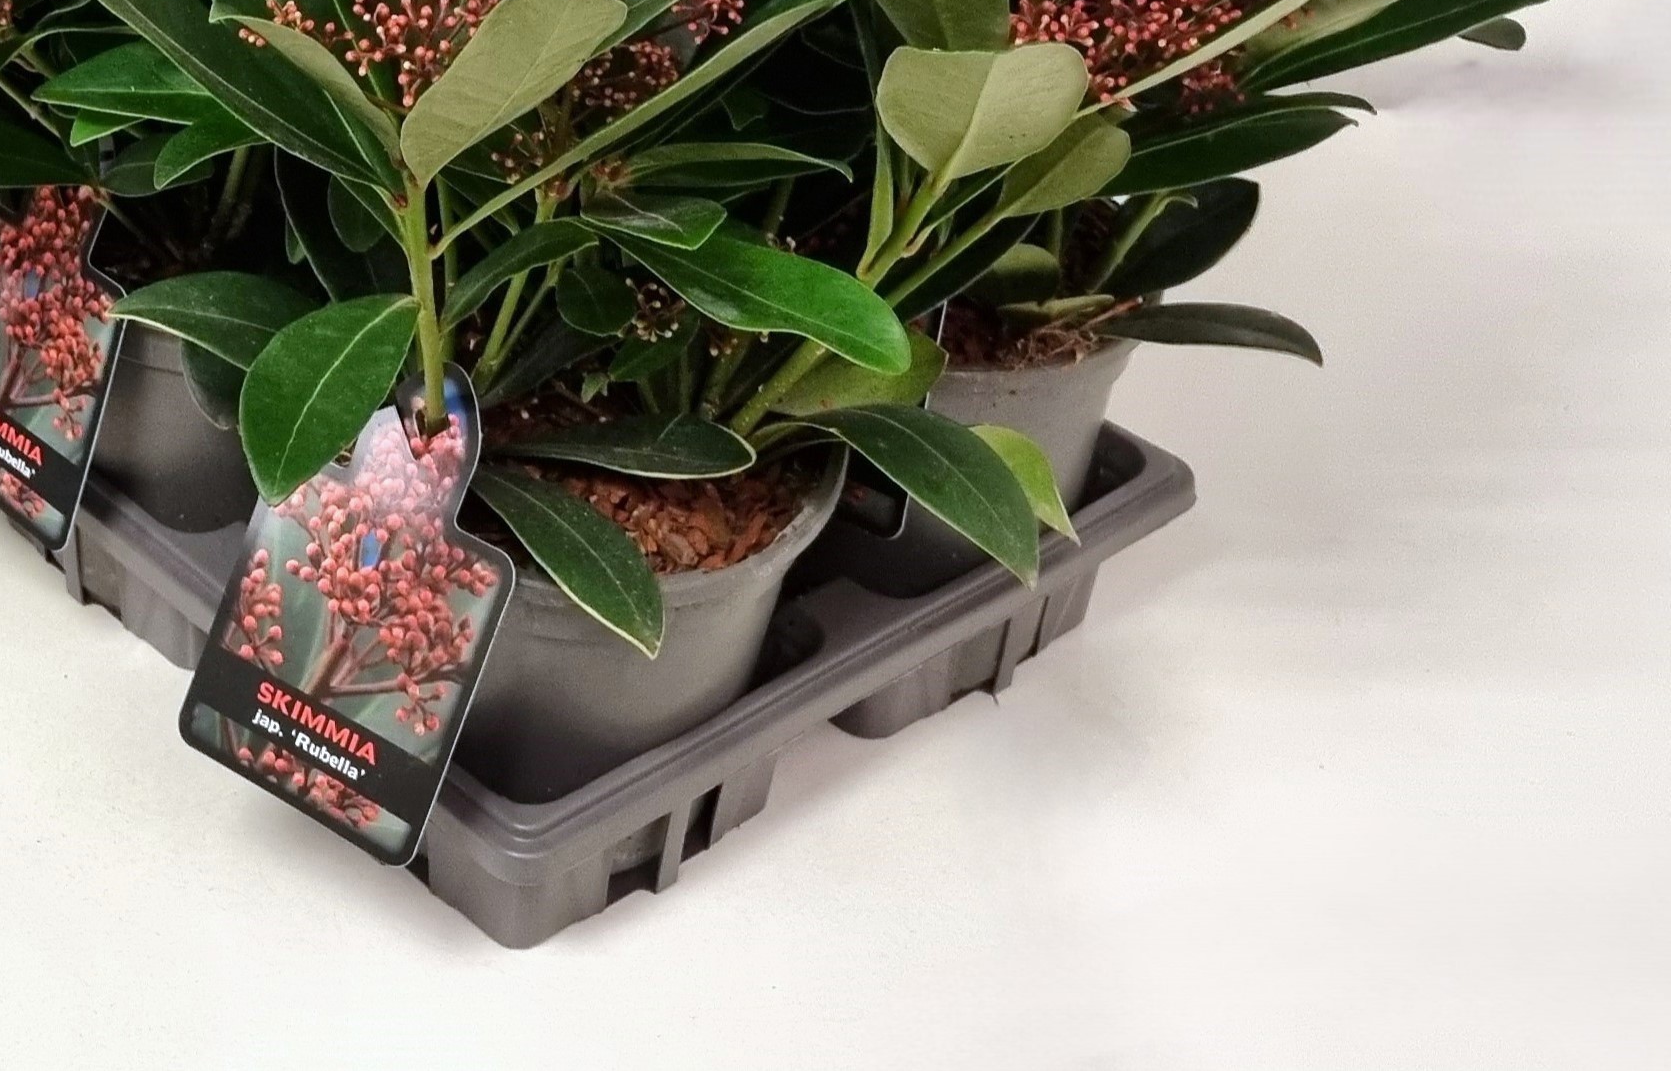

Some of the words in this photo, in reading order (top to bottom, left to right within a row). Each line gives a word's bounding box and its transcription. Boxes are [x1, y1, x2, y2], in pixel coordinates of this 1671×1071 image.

[253, 709, 283, 737] jap.
[292, 729, 366, 780] 'Rubella'
[257, 682, 376, 765] SKIMMIA
